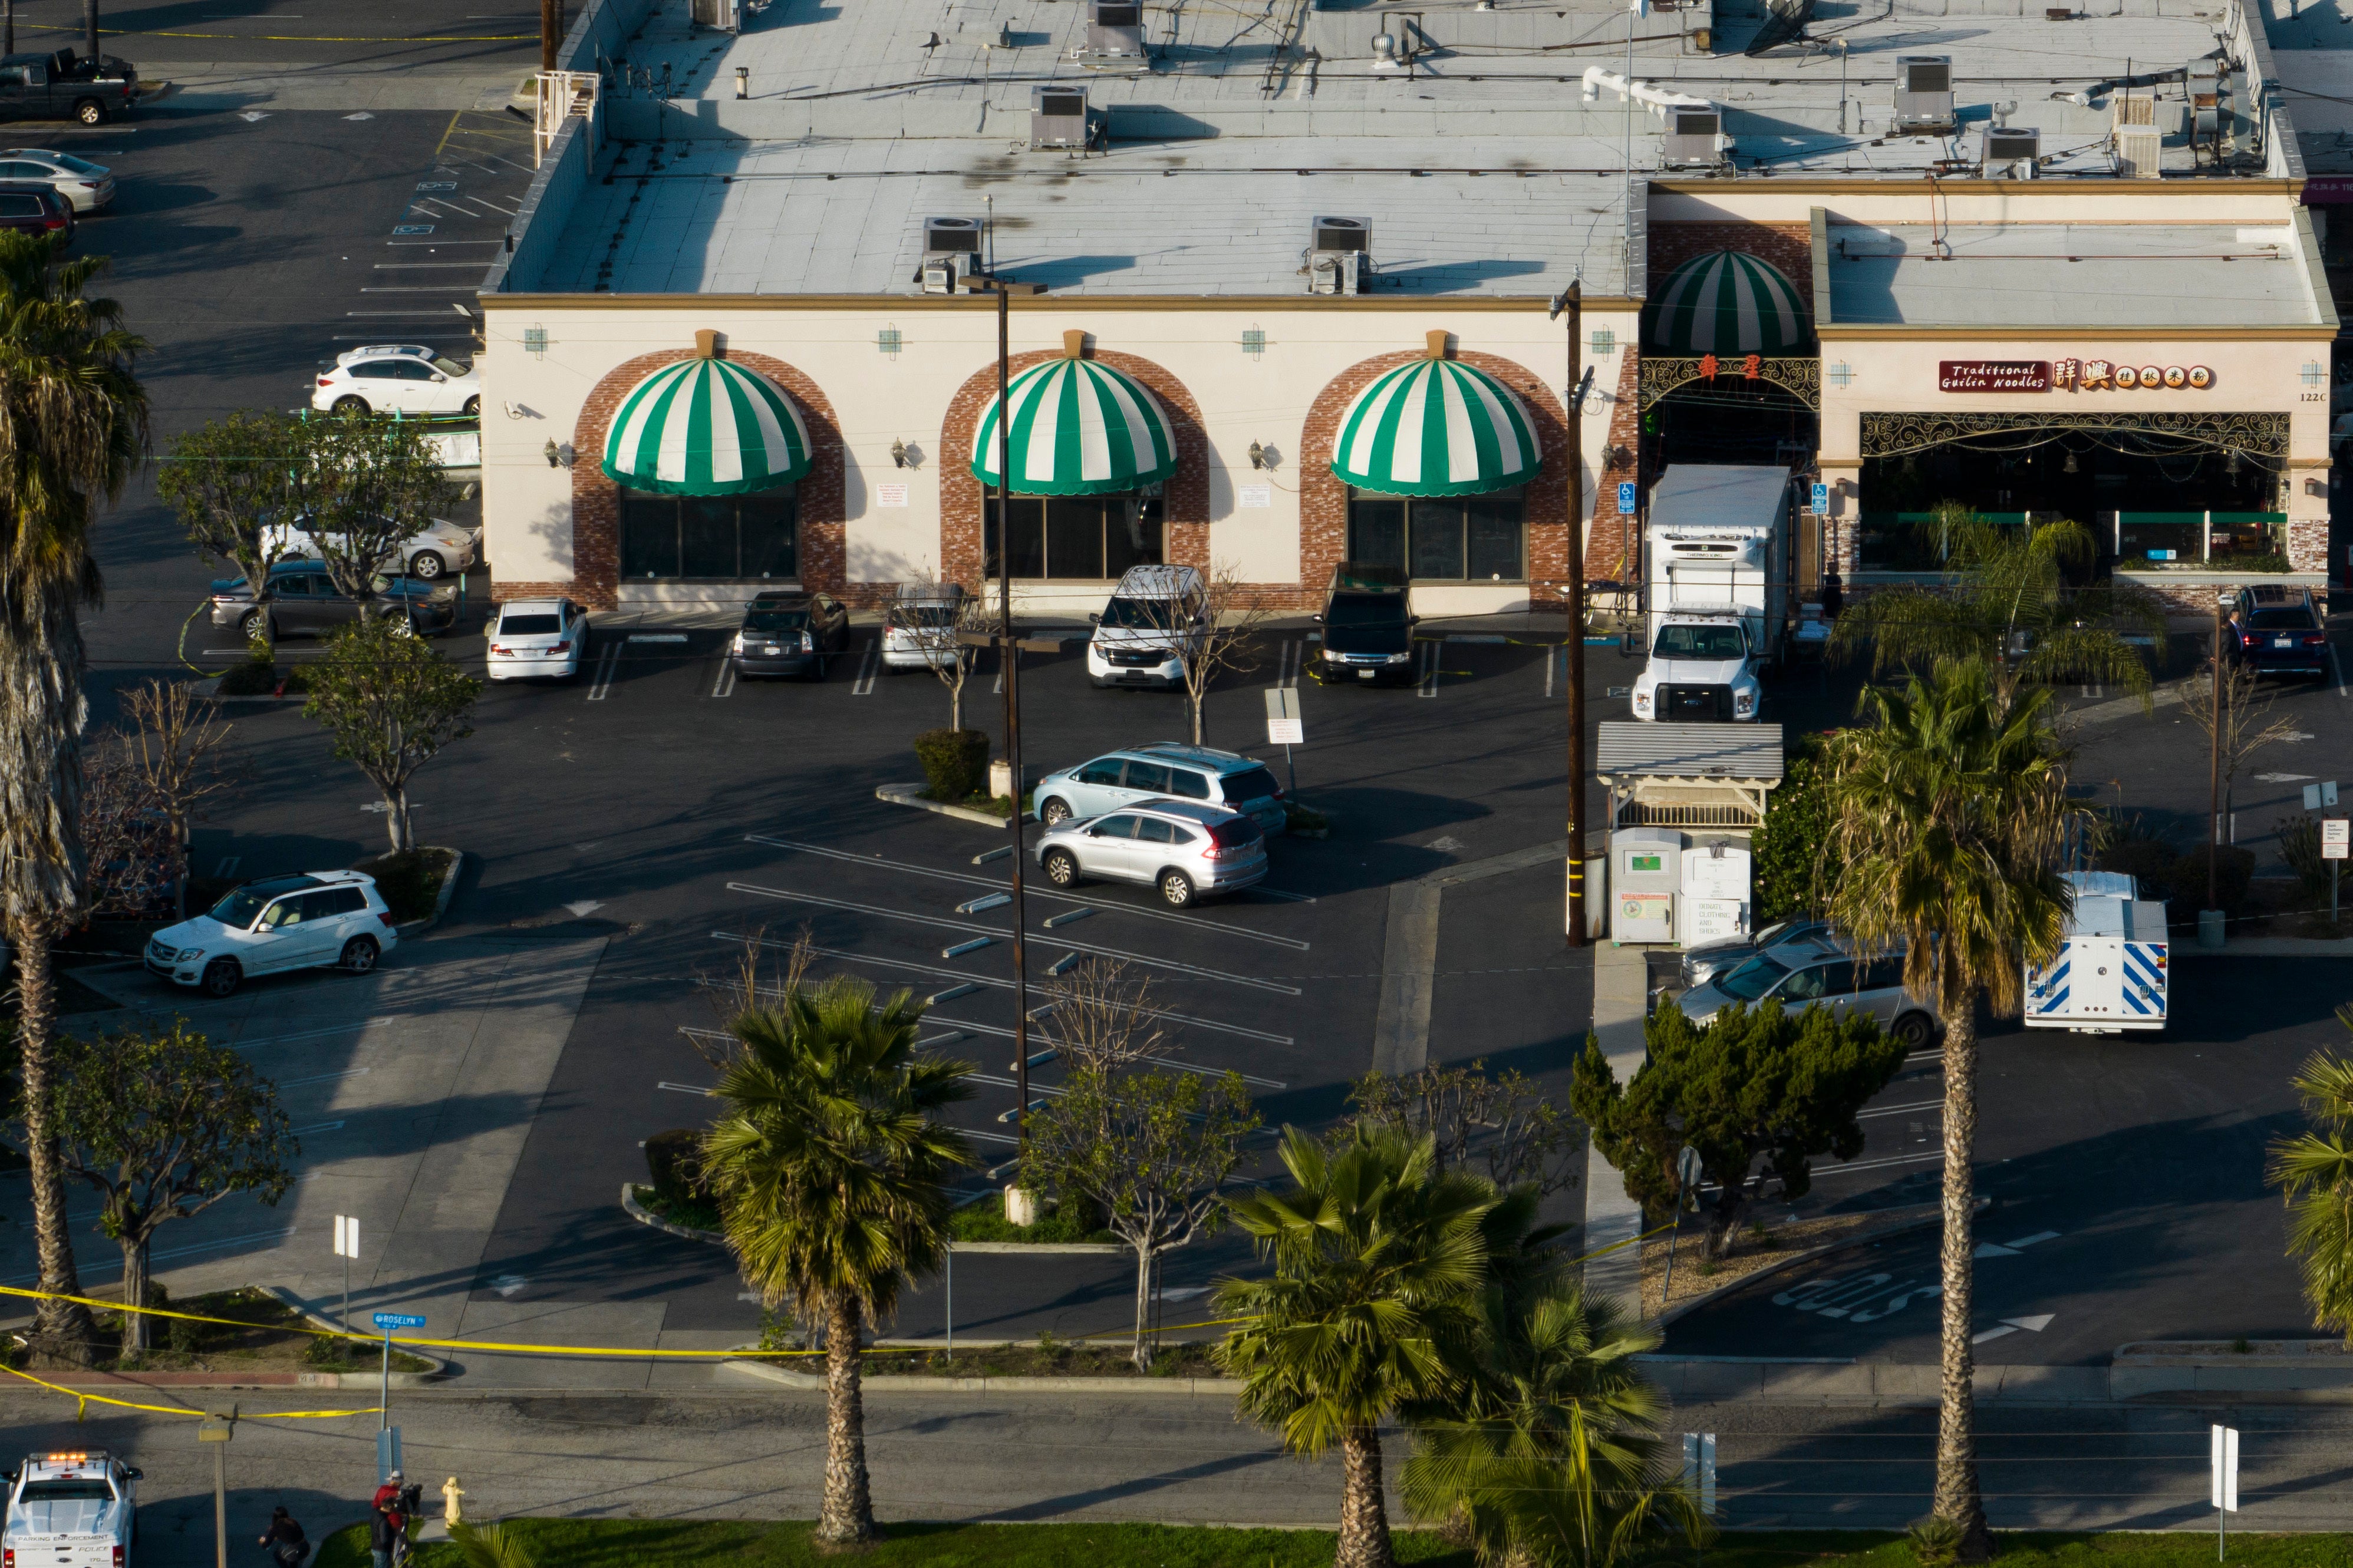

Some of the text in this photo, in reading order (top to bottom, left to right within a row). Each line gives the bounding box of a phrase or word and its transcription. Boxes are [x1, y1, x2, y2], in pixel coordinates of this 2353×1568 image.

[1952, 364, 2036, 376] Traditional
[1942, 375, 2045, 388] Guilin Noodles
[2300, 393, 2327, 402] 122C
[383, 1315, 416, 1325] ROSELYN
